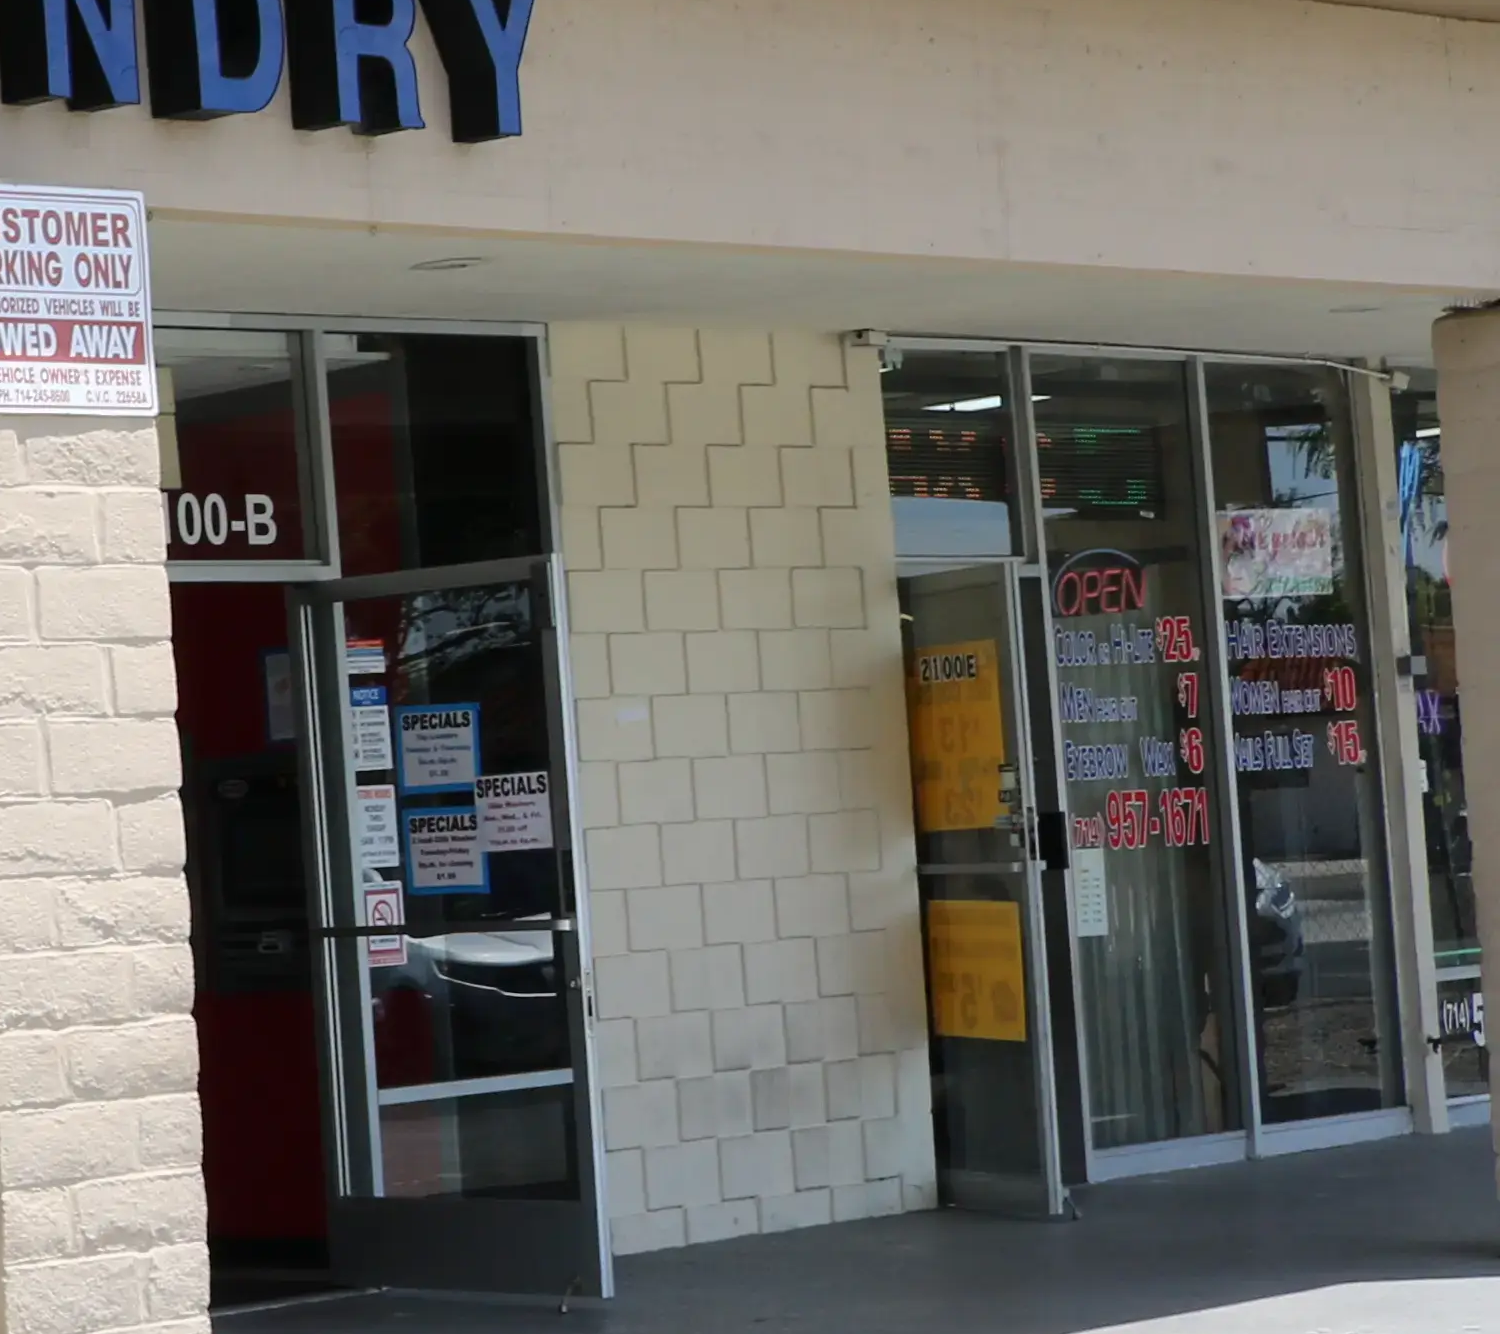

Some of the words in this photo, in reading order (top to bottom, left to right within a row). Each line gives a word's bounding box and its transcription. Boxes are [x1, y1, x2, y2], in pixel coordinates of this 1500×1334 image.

[74, 251, 133, 289] ONLY
[44, 298, 95, 316] VEHICLES
[100, 300, 123, 317] WILL
[128, 301, 140, 317] BE
[69, 324, 137, 360] AWAY
[40, 368, 90, 385] OWNER'S
[95, 369, 142, 386] EXPENSE
[1056, 568, 1147, 616] OPEN
[1225, 619, 1266, 660] HAIR
[1266, 619, 1357, 659] EXTENSIONS
[920, 654, 977, 682] 2100E
[1060, 682, 1093, 724] MEN
[1177, 673, 1198, 718] $7
[1323, 666, 1357, 712] $10
[402, 711, 471, 731] SPECIALS
[1064, 740, 1129, 781] EYEBROW
[1139, 736, 1176, 777] WAX
[1180, 727, 1204, 774] $6
[1327, 720, 1361, 765] $15
[475, 774, 548, 799] SPECIALS
[409, 814, 477, 834] SPECIALS
[1071, 810, 1106, 848] (714)
[1105, 787, 1210, 851] 957-1671
[1443, 998, 1470, 1035] (714)
